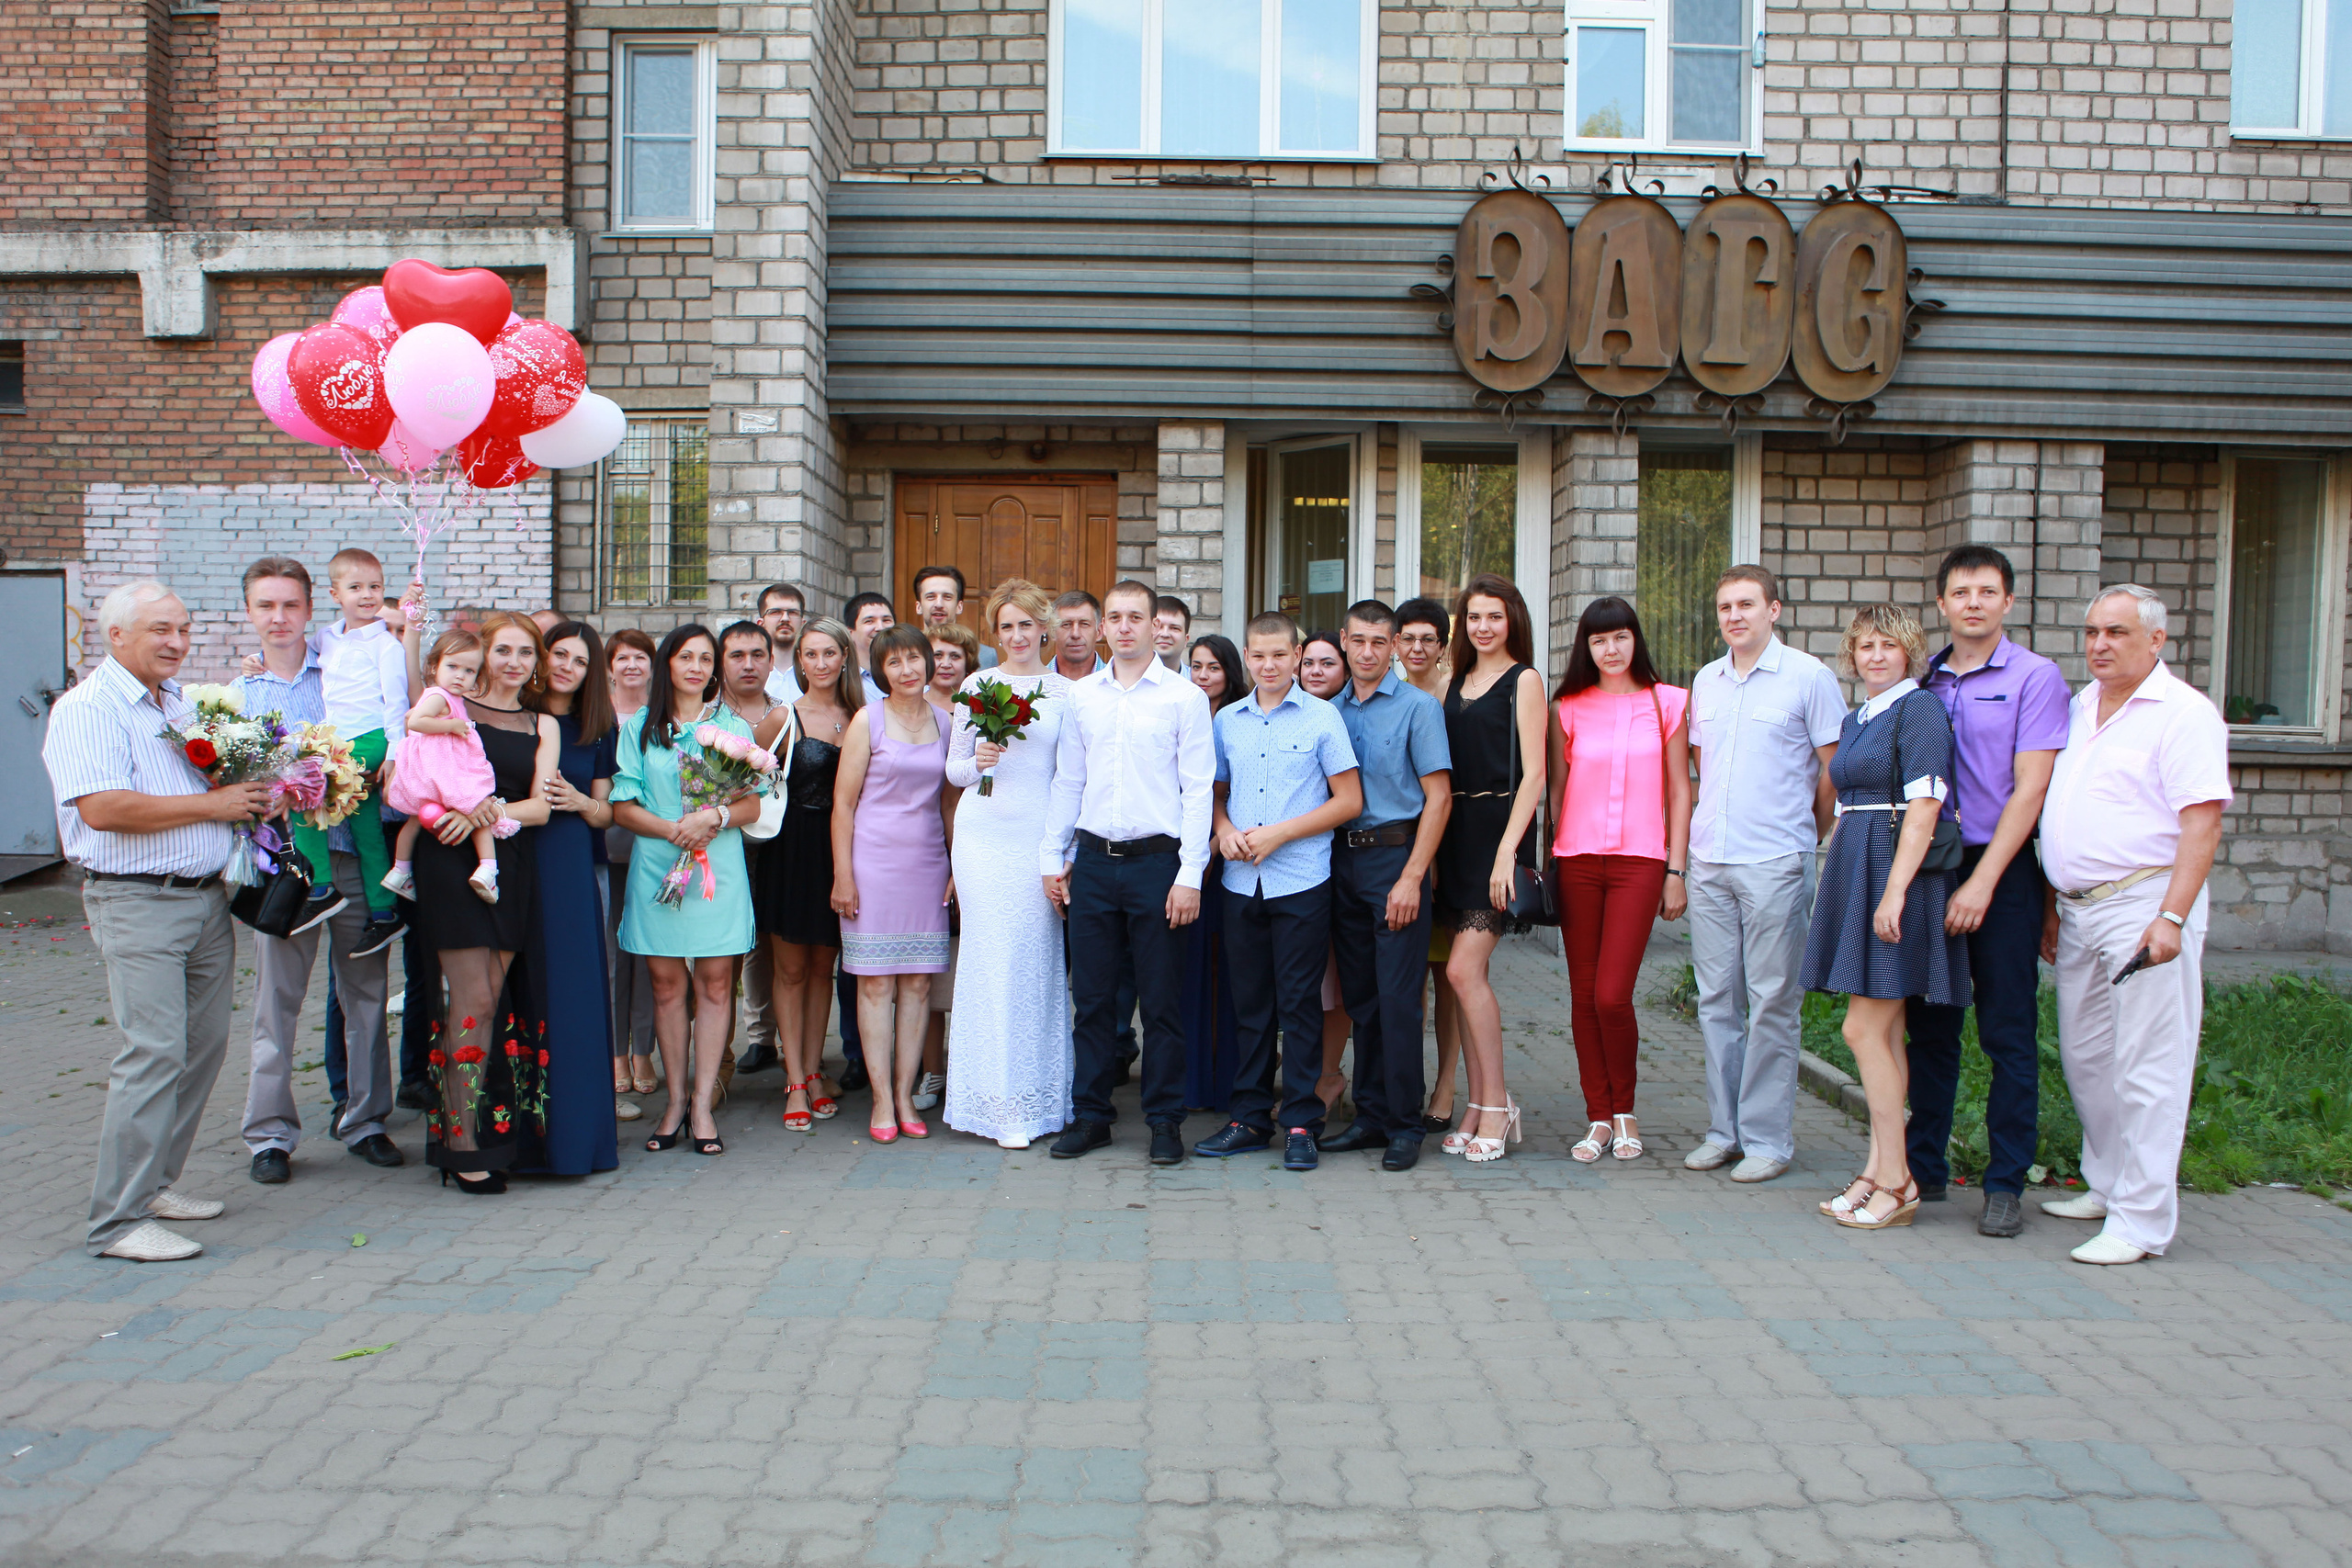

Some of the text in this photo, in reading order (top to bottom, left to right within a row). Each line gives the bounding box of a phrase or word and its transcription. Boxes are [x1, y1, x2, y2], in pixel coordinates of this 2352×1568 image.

[1475, 217, 1893, 374] ЗАГС
[326, 364, 374, 410] Люблю
[425, 382, 482, 412] Люблю
